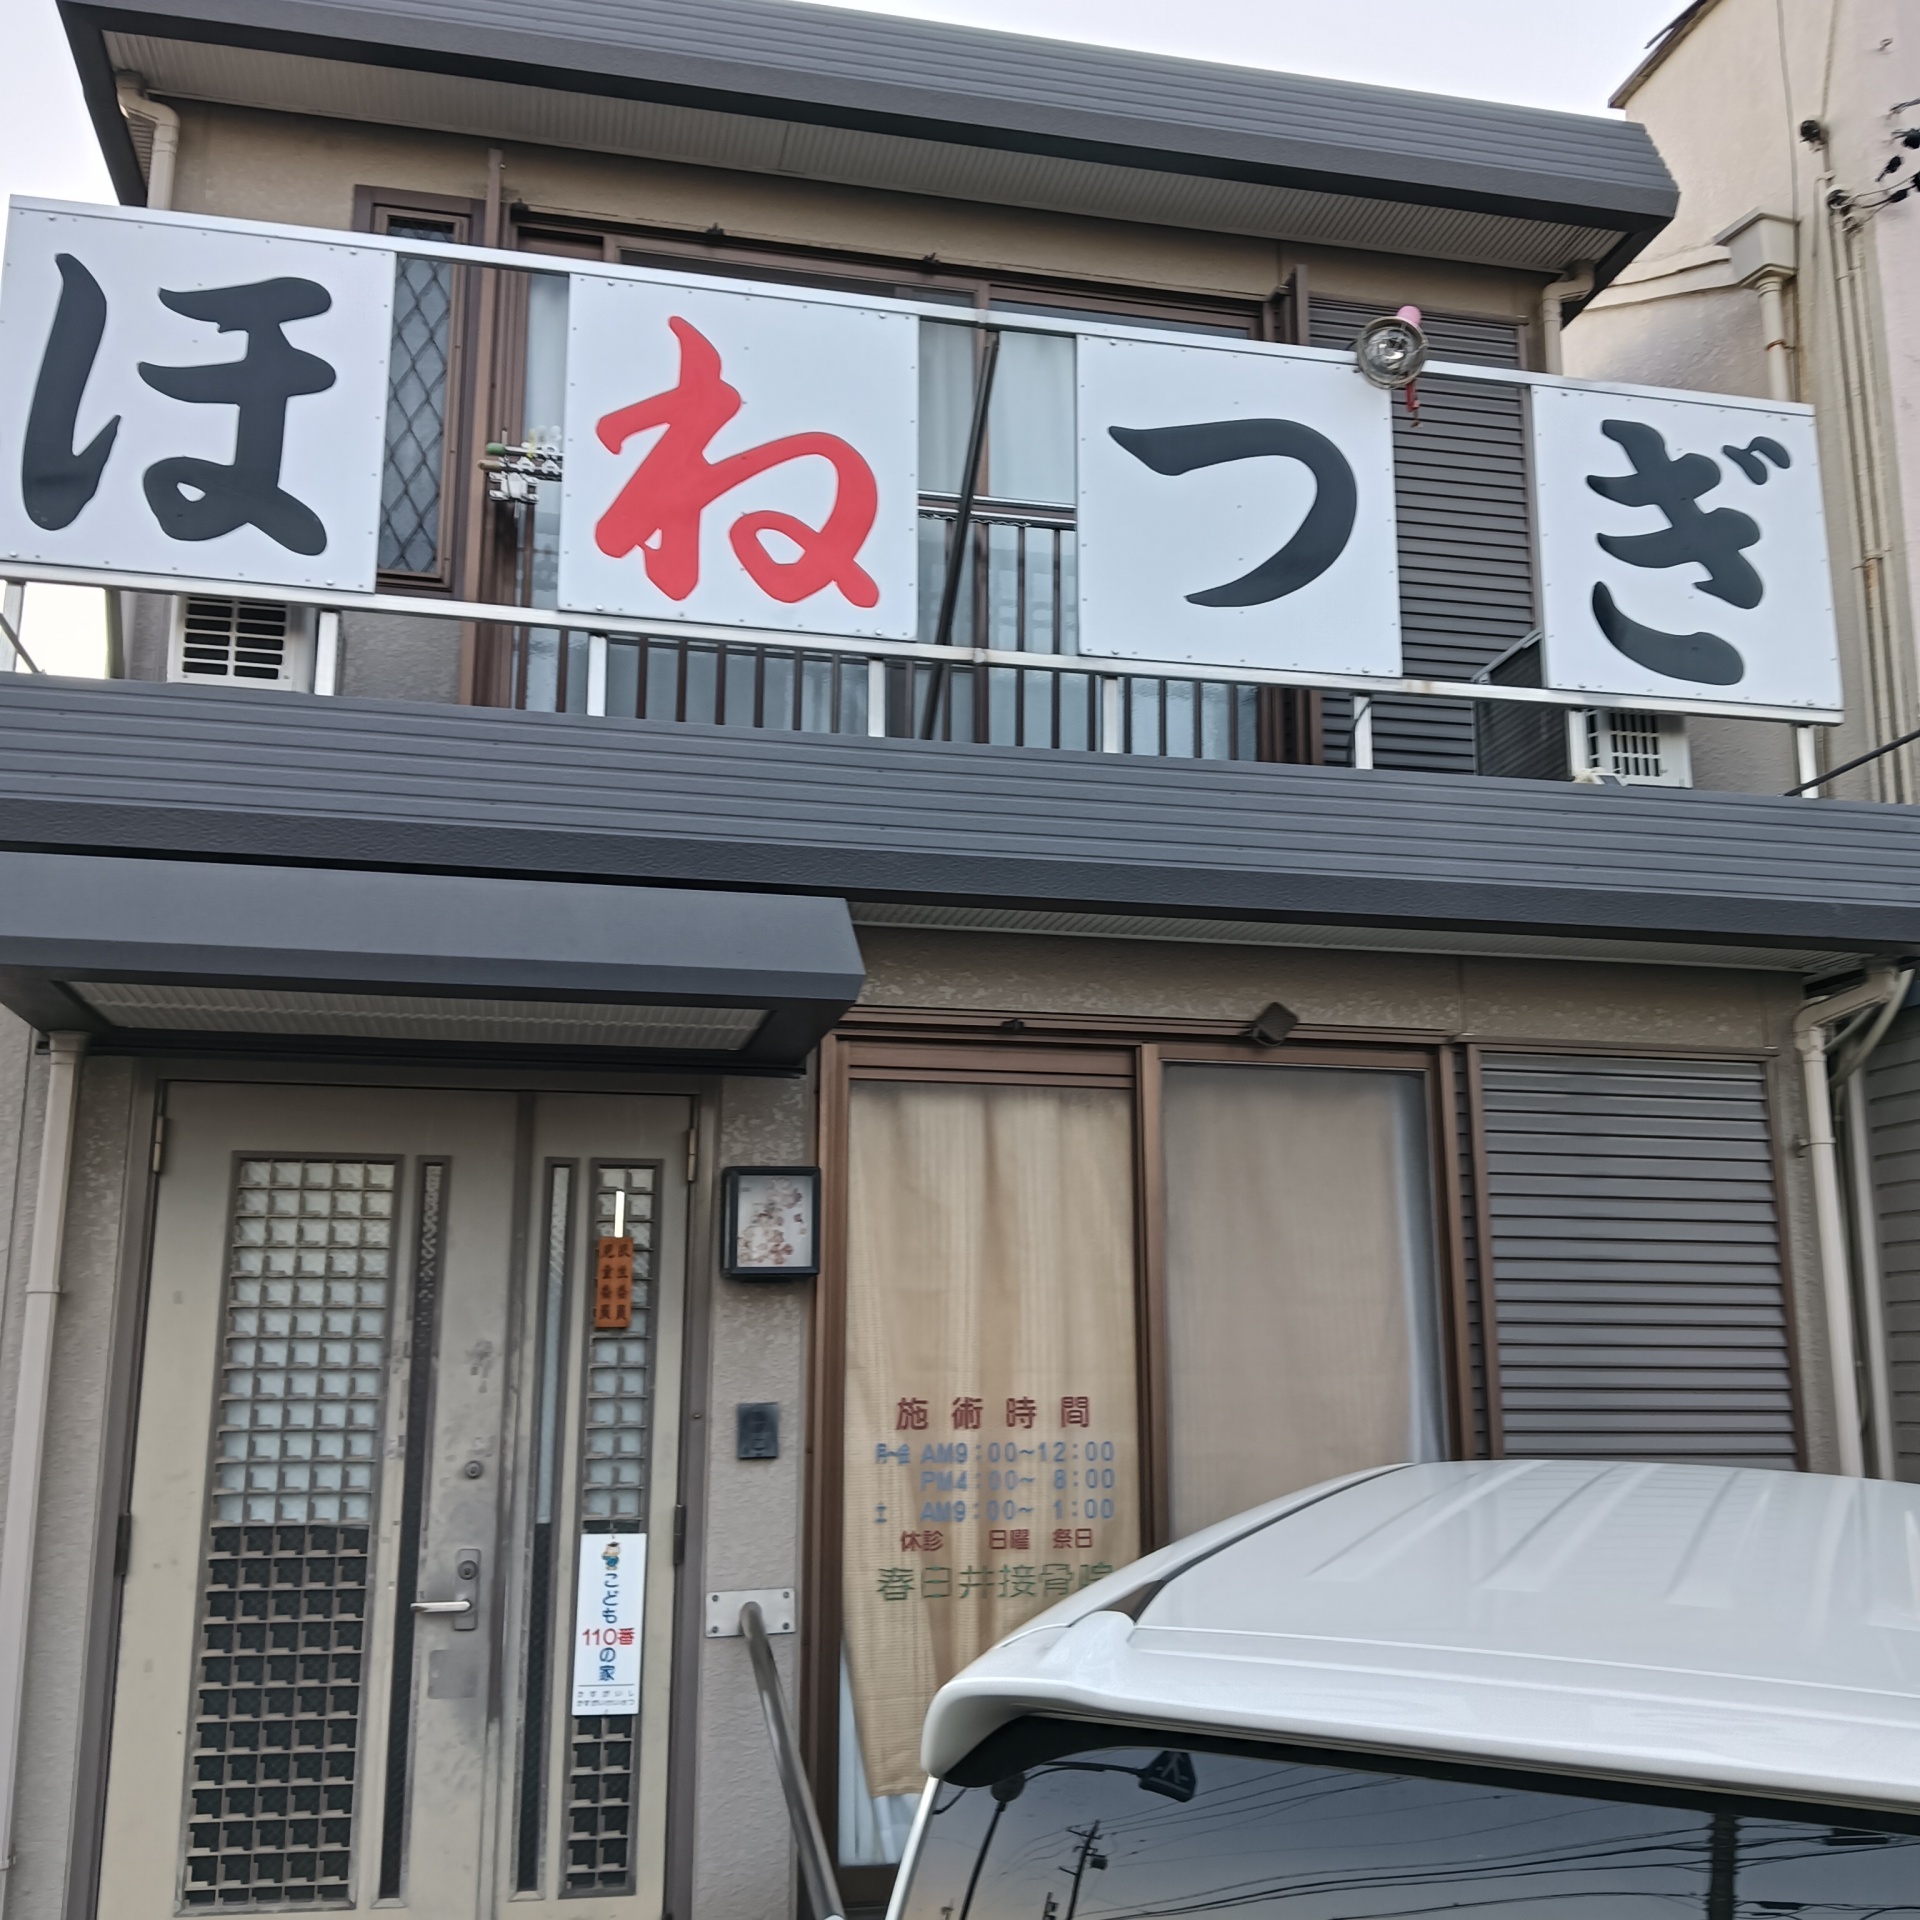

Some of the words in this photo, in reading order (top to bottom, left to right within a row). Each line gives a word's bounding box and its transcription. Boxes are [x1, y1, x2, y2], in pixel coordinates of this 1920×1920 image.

[18, 253, 1790, 686] ほねつぎ
[896, 1396, 1089, 1430] 施術時間
[900, 1531, 943, 1552] 休診
[988, 1529, 1030, 1550] 日曜
[1051, 1528, 1093, 1549] 祭日
